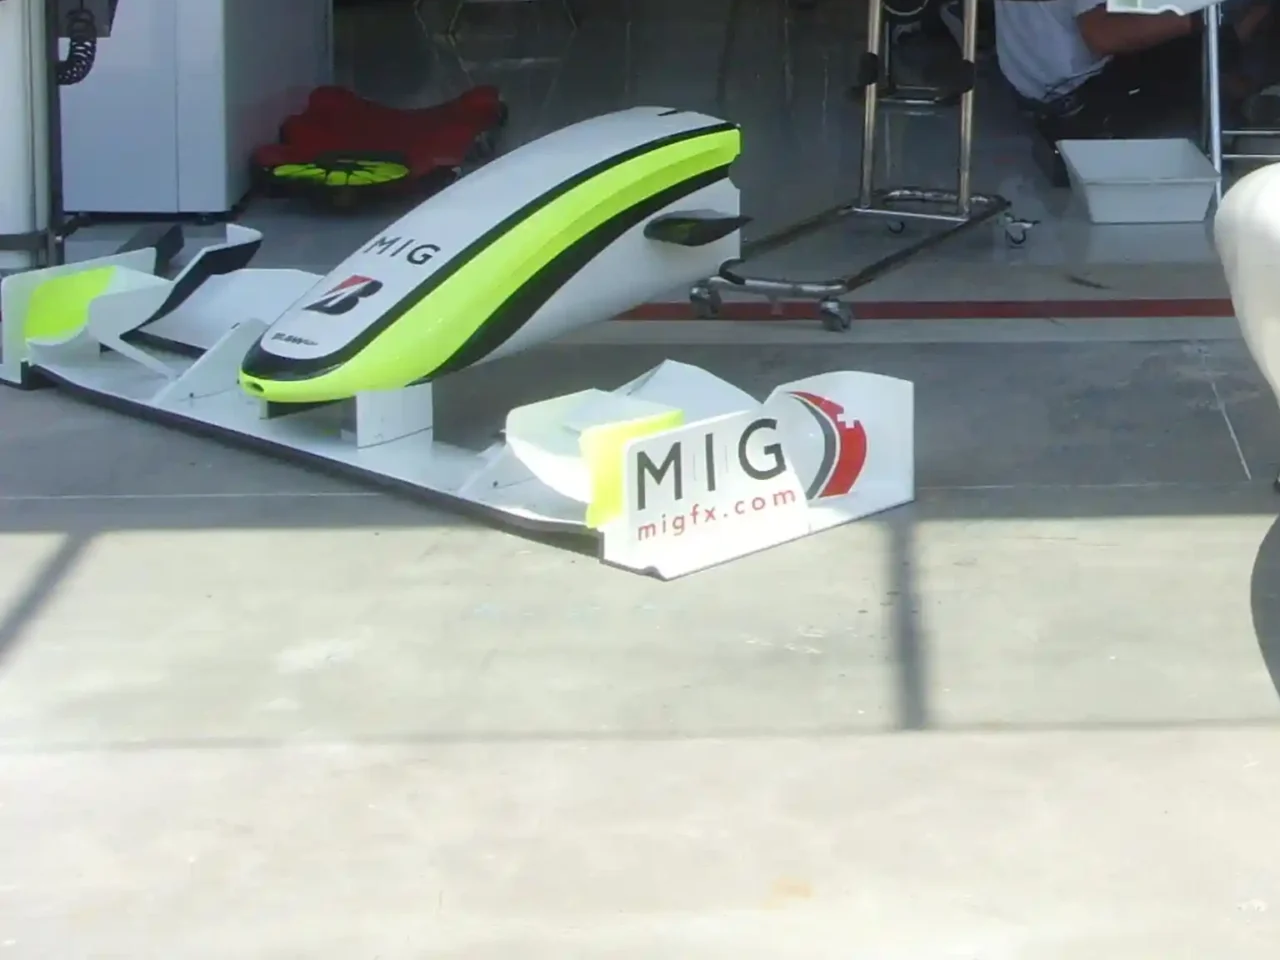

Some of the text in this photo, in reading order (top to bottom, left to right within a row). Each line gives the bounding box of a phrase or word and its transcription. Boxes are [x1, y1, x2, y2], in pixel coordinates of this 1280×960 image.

[363, 236, 442, 266] MIG
[636, 418, 787, 511] MIG
[637, 488, 797, 541] migfx.com
